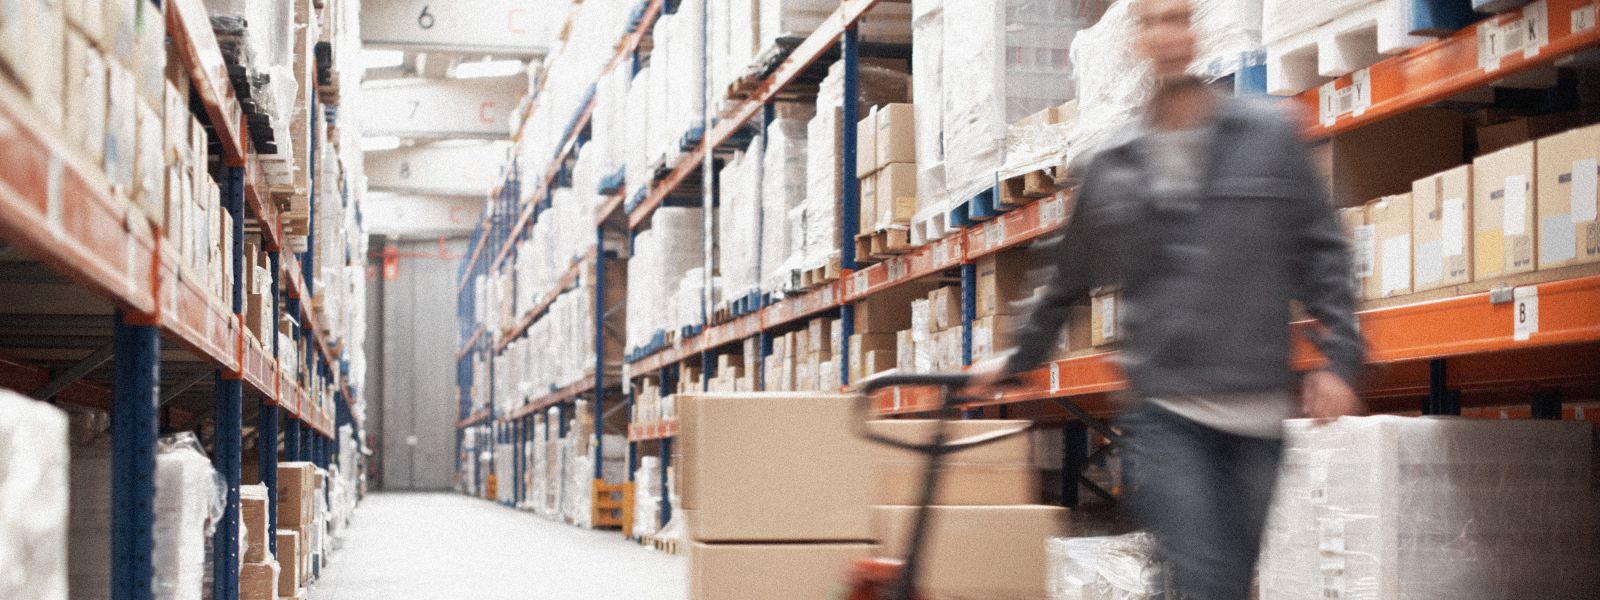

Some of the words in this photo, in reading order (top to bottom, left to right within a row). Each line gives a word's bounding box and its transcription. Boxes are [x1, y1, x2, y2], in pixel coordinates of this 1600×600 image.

[418, 6, 434, 29] 6
[1528, 18, 1536, 41] K
[1490, 33, 1496, 55] T
[1356, 82, 1362, 101] Y
[408, 101, 420, 119] 7
[480, 101, 496, 123] C
[1520, 302, 1526, 324] B
